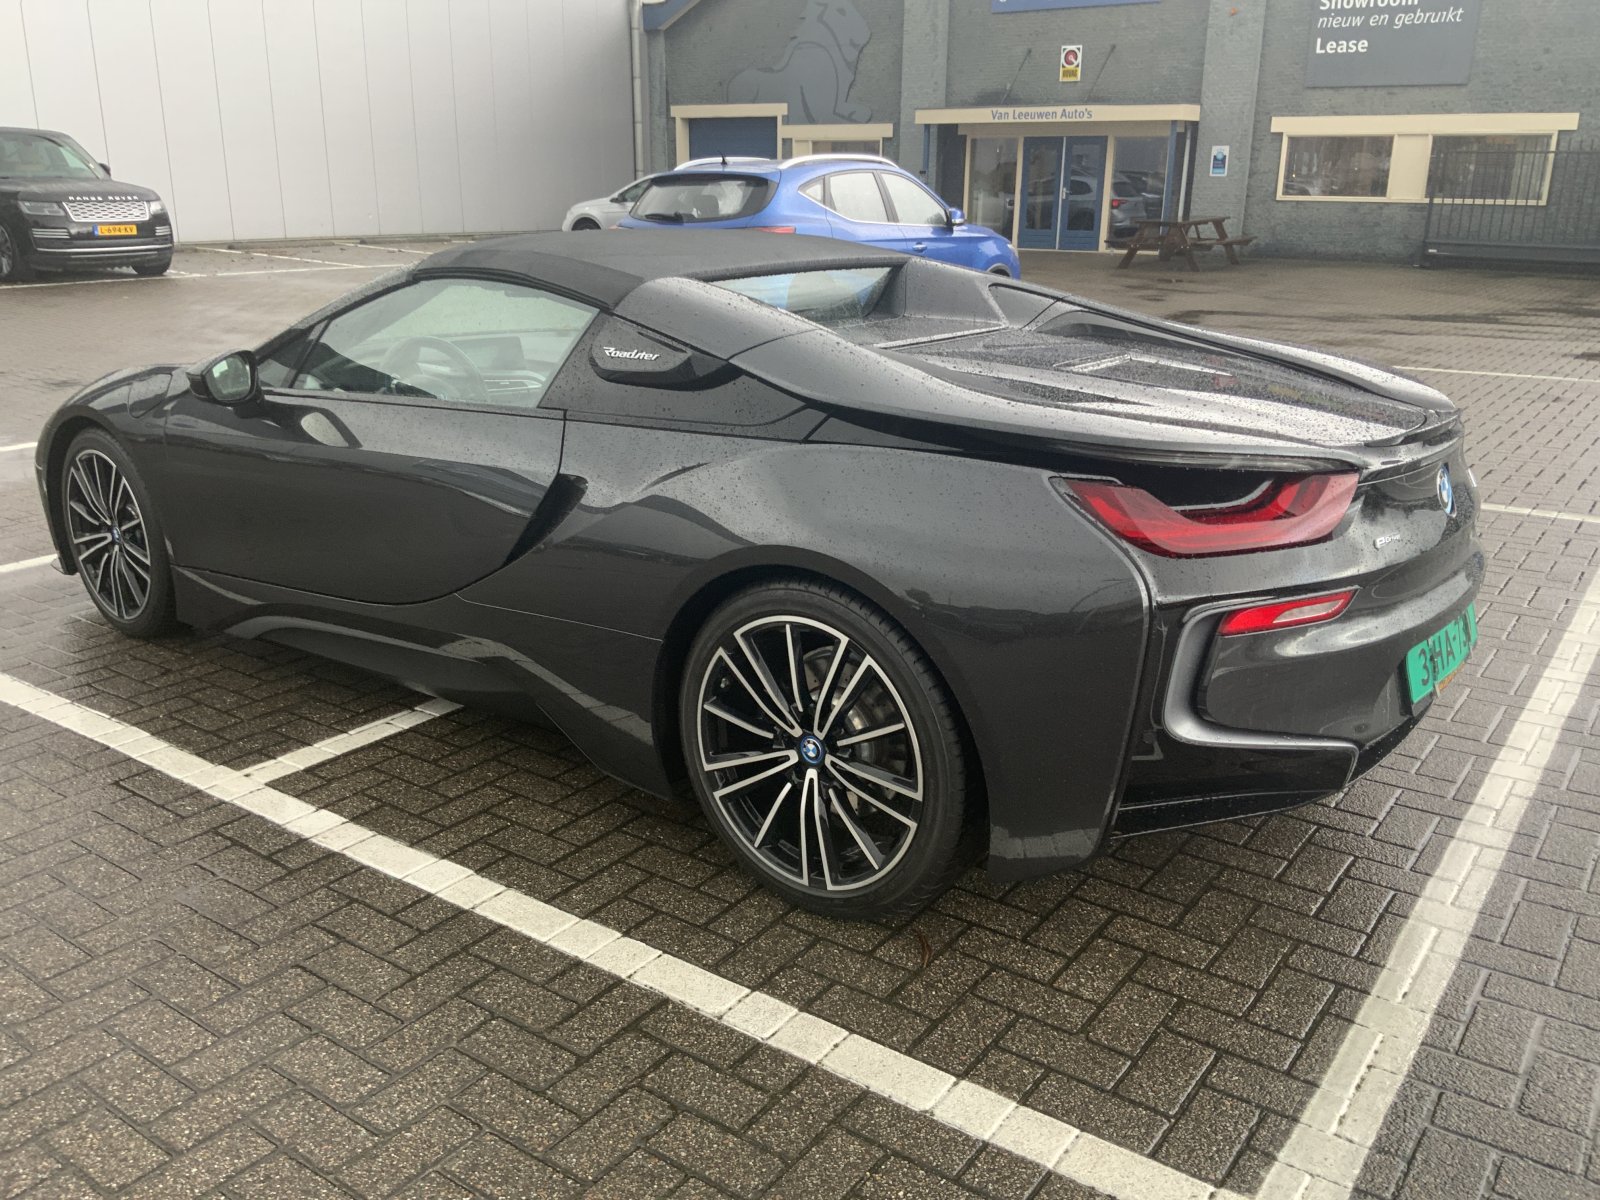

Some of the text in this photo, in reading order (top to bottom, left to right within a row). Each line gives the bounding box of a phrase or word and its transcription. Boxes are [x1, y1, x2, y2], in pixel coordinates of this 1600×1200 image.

[1317, 6, 1465, 29] nieuw en gebruikt
[1315, 37, 1369, 54] Lease
[991, 107, 1093, 120] Van Leeuwen Auto's
[603, 346, 660, 361] Roadster
